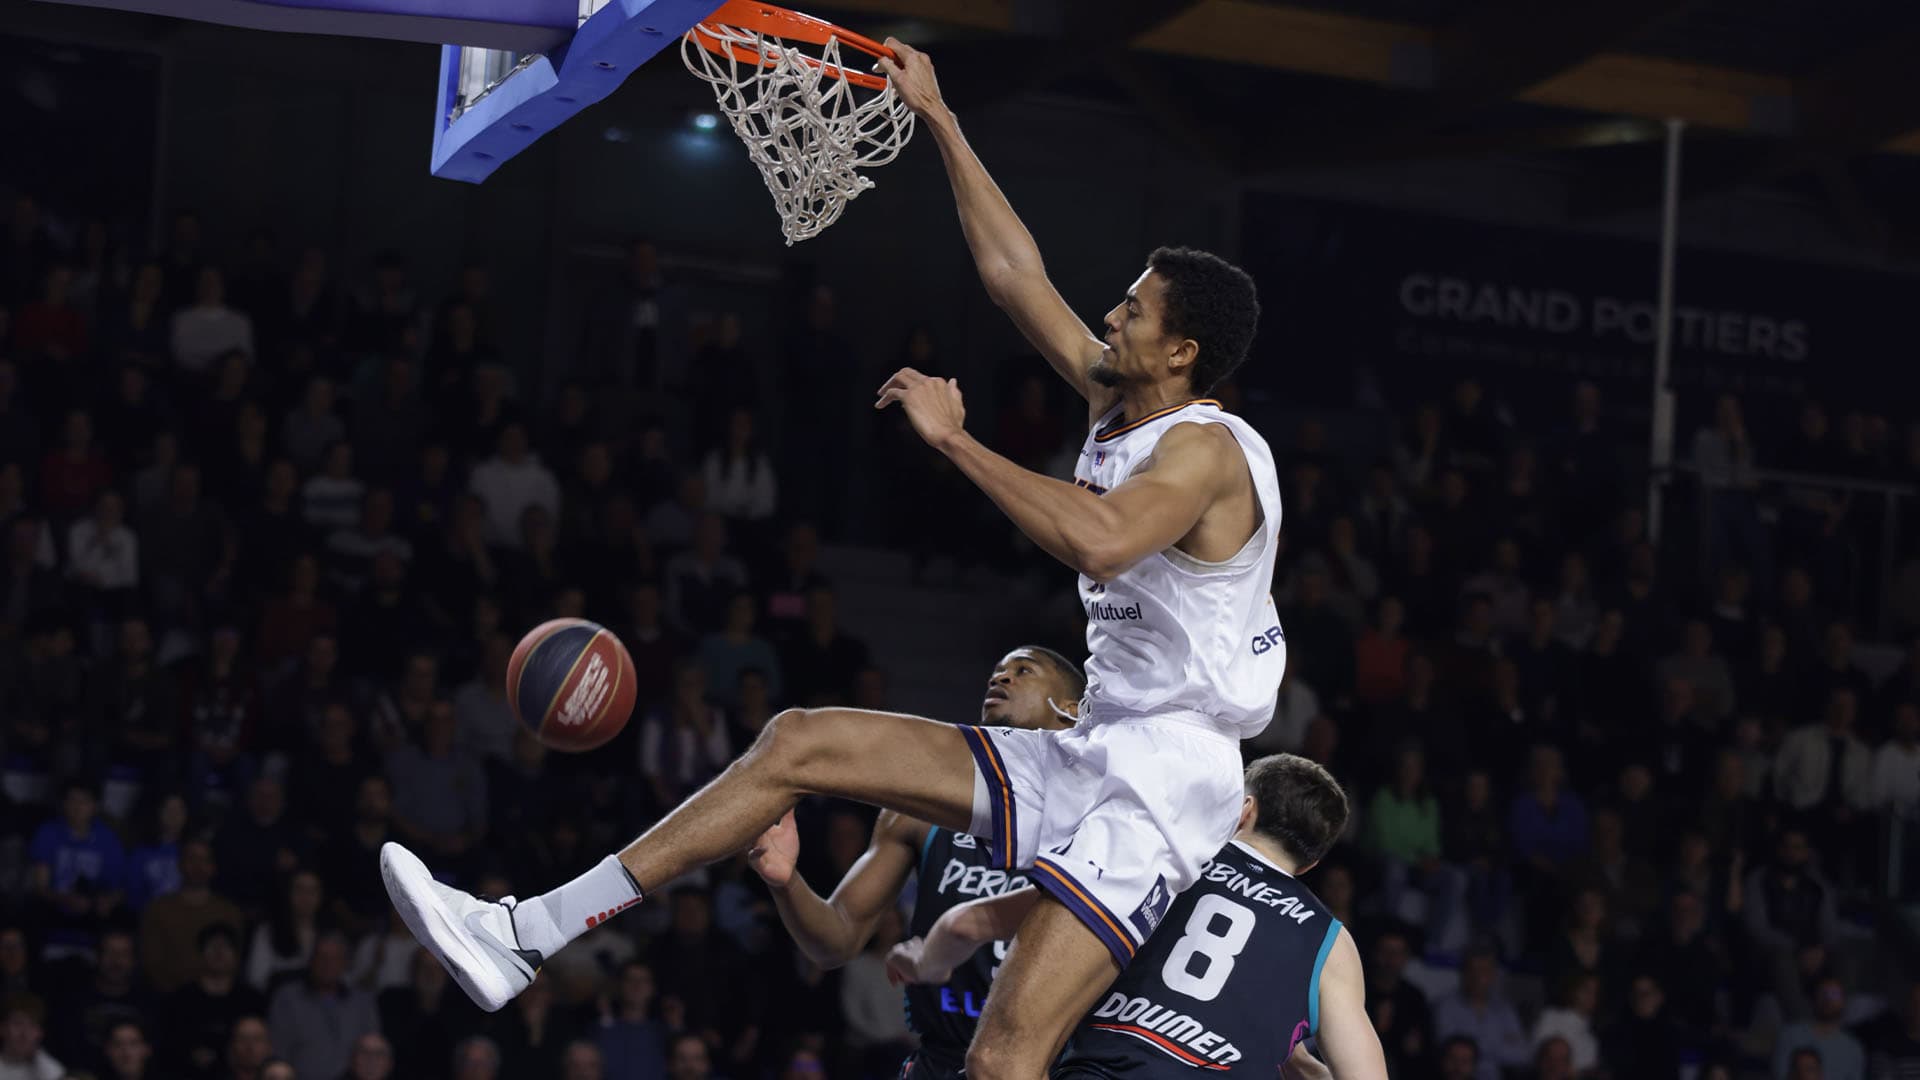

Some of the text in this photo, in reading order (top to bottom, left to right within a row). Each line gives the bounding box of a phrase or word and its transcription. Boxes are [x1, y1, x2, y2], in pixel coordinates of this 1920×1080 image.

[1399, 272, 1809, 361] GRAND POTIERS
[1090, 601, 1143, 620] Mutuel
[1161, 893, 1256, 1001] 8
